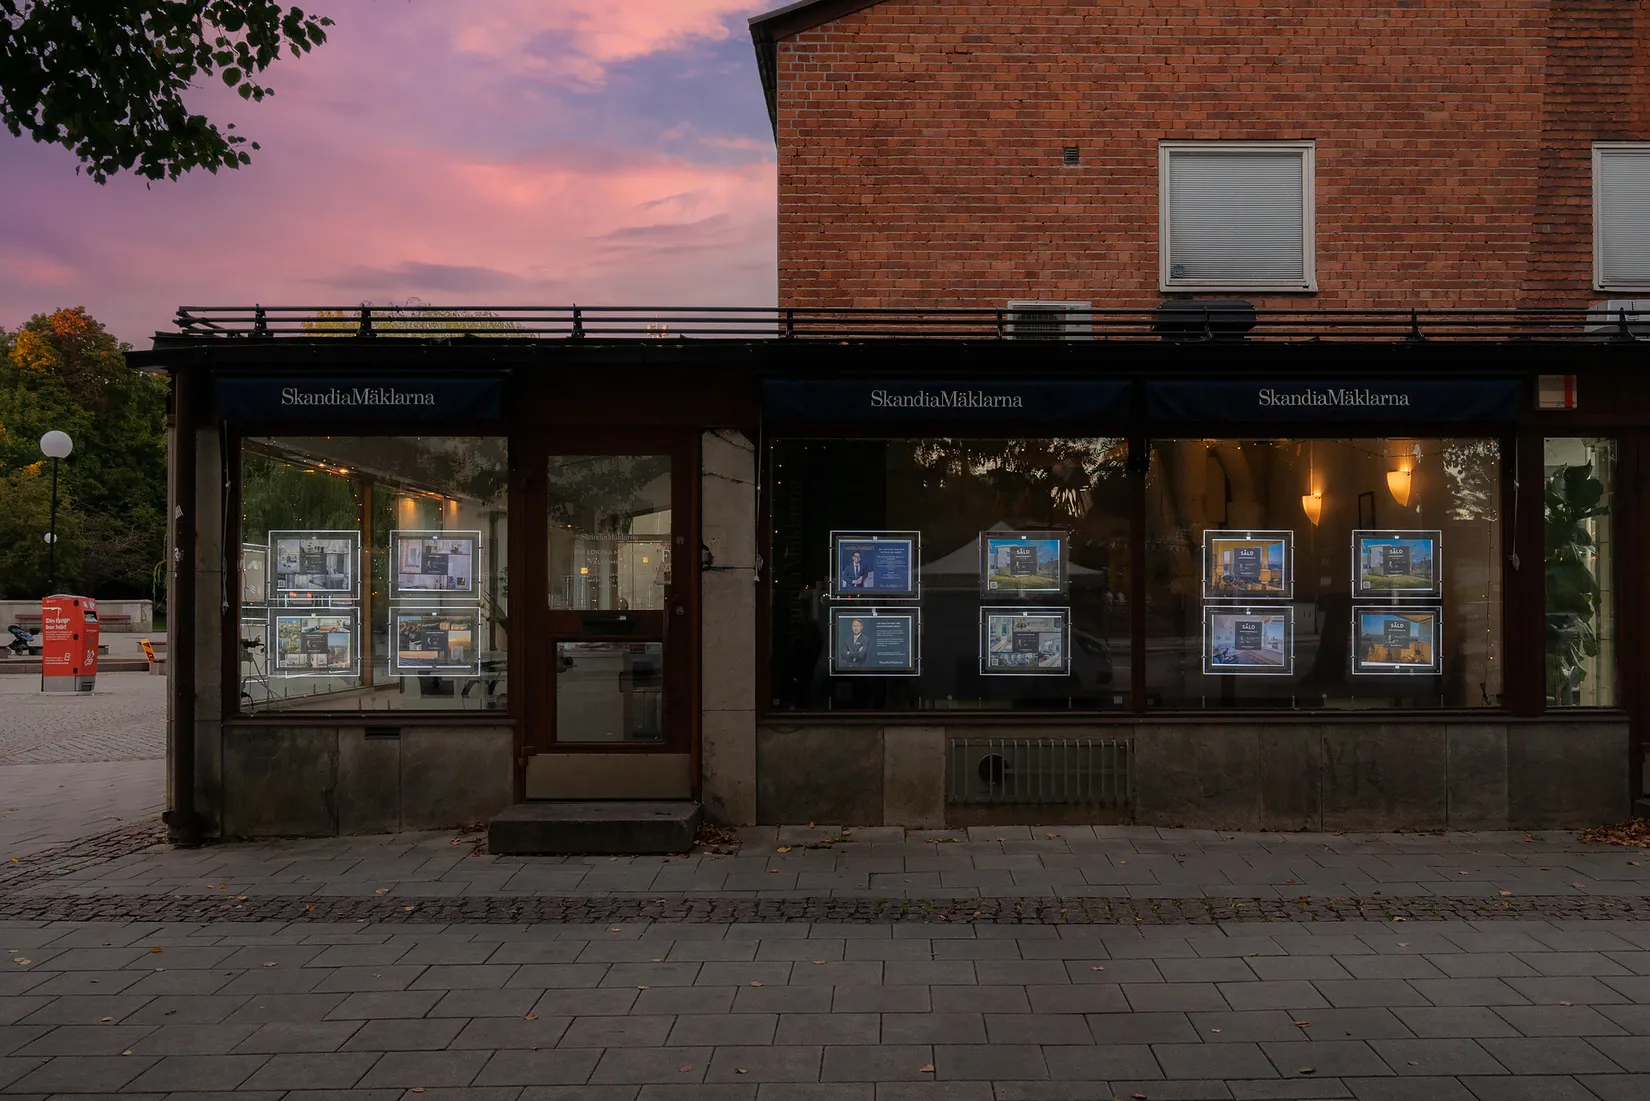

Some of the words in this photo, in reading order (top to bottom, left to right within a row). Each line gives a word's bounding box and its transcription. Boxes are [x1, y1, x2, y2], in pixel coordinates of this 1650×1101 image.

[281, 388, 435, 404] SkandiaMäklarna
[871, 391, 1023, 407] SkandiaMäklarna
[1258, 389, 1410, 405] SkandiaMäklarna
[1242, 622, 1256, 630] SÅLD
